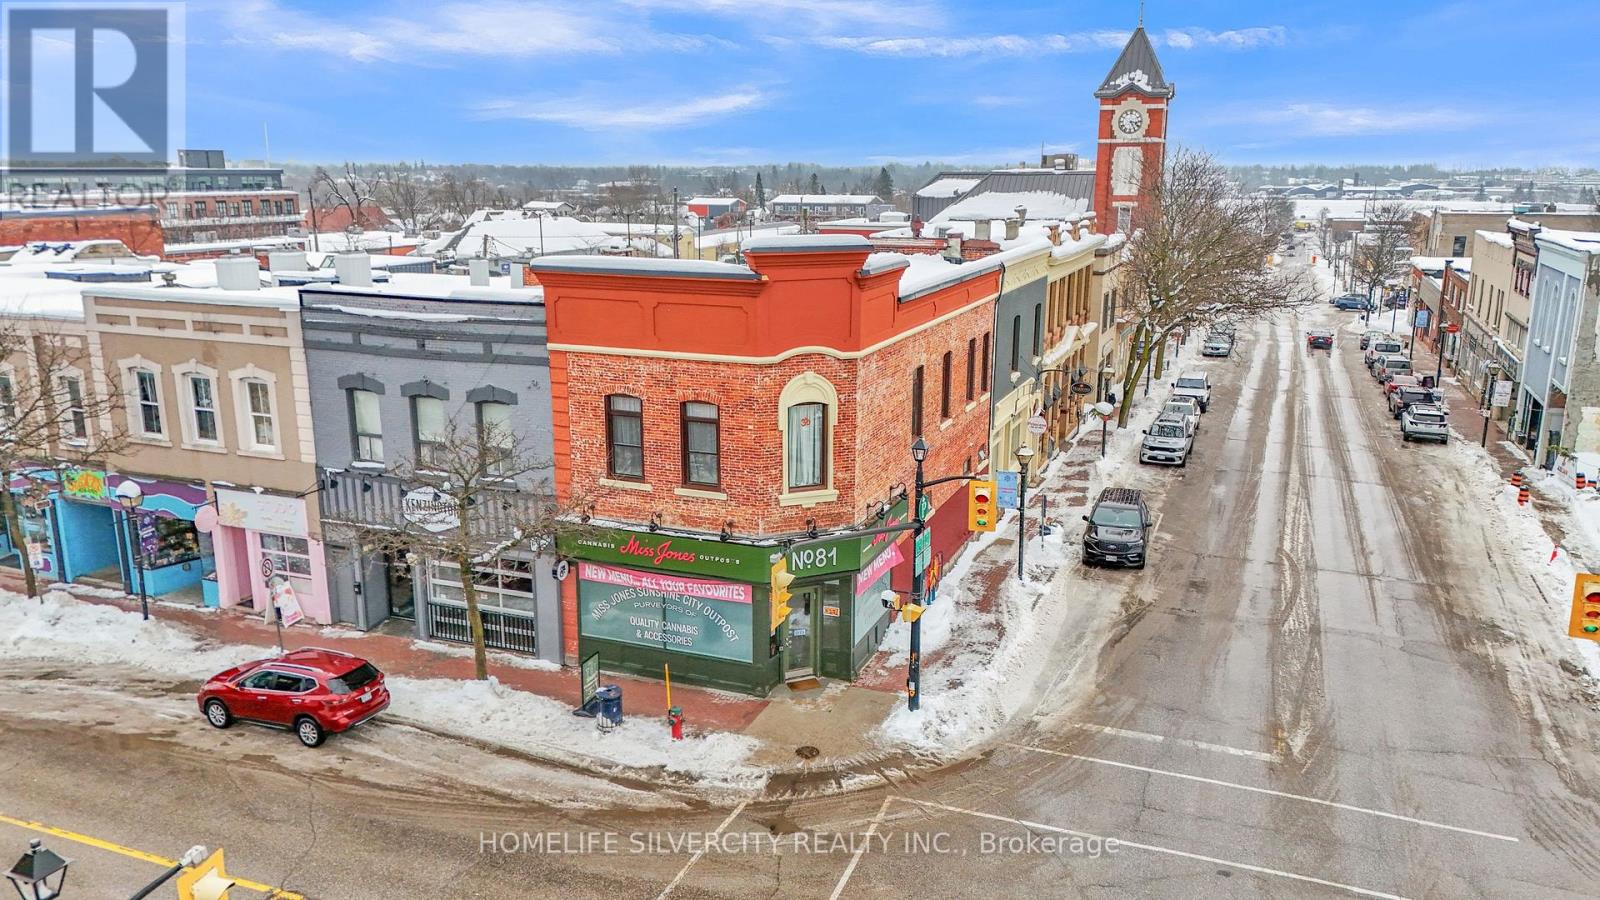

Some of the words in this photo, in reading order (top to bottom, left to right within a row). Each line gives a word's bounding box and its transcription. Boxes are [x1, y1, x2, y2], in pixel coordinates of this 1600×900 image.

[577, 539, 615, 549] CANNABIS
[620, 534, 655, 557] Miss
[654, 540, 696, 565] Jones
[585, 565, 607, 579] NEW
[641, 577, 659, 590] ALL
[660, 580, 686, 593] YOUR
[687, 583, 745, 600] FAVOURITES
[856, 564, 873, 585] NEW
[591, 601, 611, 621] MISS
[610, 589, 637, 605] JONES
[638, 587, 681, 601] SUNSHINE
[682, 595, 703, 611] CITY
[703, 606, 740, 643] OUTPOST
[633, 601, 684, 613] PURVEYORS
[684, 609, 699, 617] OF
[629, 615, 660, 629] QUALITY
[661, 620, 699, 635] CANNABIS
[636, 629, 642, 638] &
[643, 630, 693, 647] ACCESSORIES
